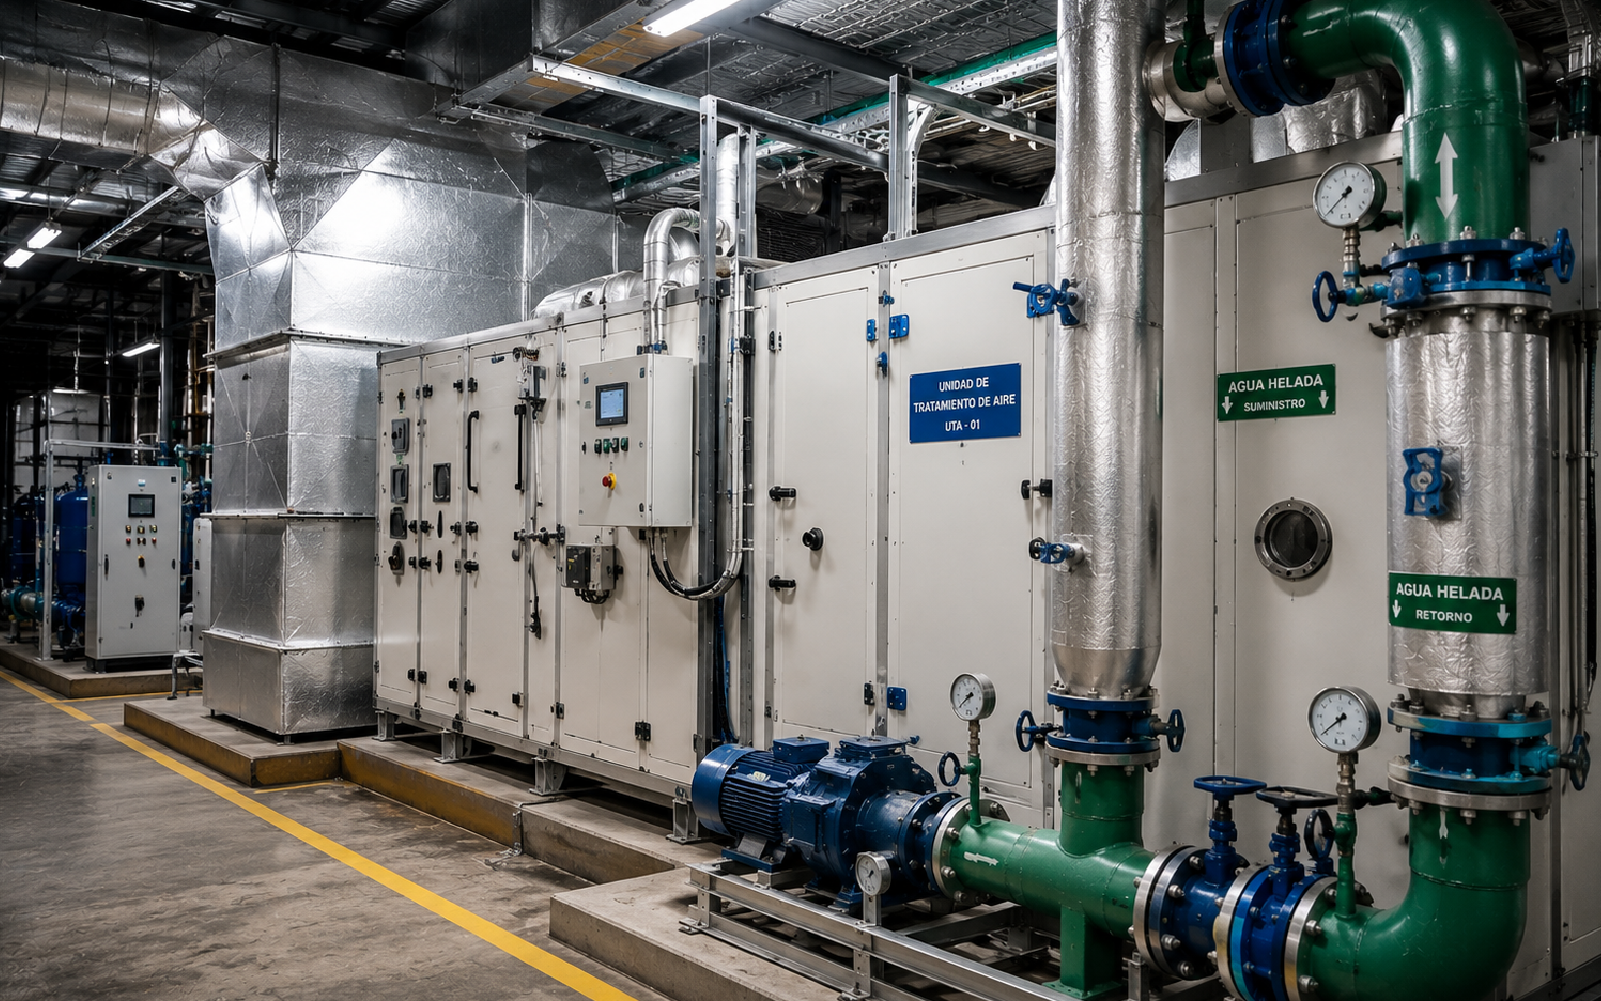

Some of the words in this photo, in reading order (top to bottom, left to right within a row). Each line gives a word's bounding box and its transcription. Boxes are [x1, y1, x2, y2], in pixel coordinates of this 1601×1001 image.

[939, 379, 974, 392] UNIDAD
[976, 377, 989, 388] DE
[1228, 380, 1265, 393] AGUA
[1268, 374, 1323, 389] HELADA
[913, 397, 976, 413] TRATAMIENTO
[978, 396, 991, 408] DE
[993, 394, 1016, 406] AIRE
[1243, 398, 1306, 412] SUMINISTRO
[945, 420, 963, 431] UTA
[970, 419, 980, 430] 01
[1396, 582, 1432, 598] AGUA
[1437, 585, 1504, 601] HELADA
[1416, 609, 1473, 622] RETORNO
